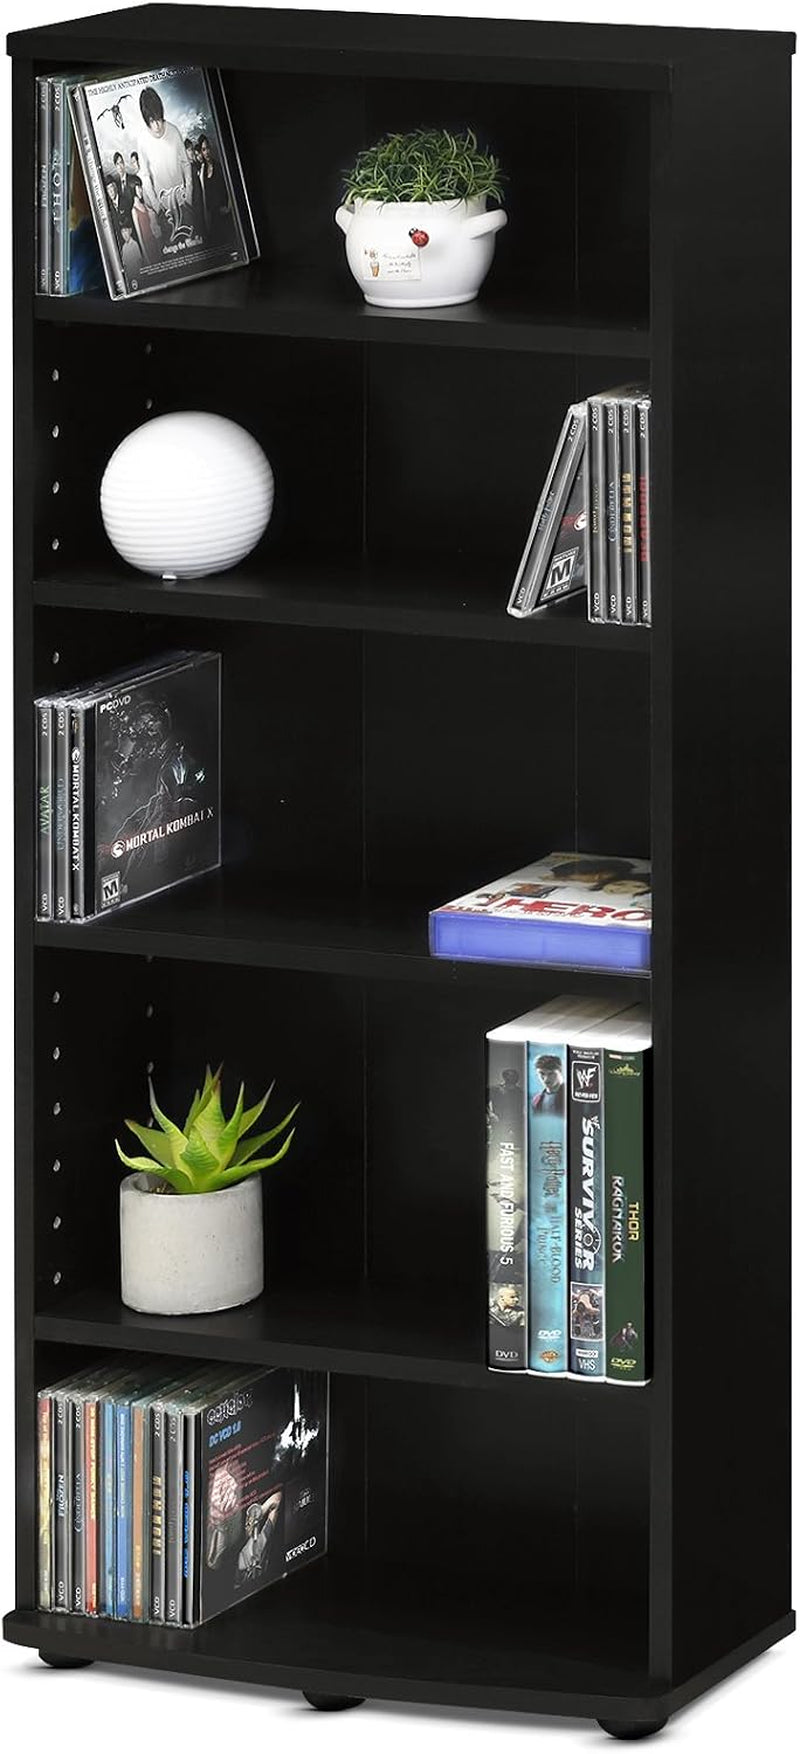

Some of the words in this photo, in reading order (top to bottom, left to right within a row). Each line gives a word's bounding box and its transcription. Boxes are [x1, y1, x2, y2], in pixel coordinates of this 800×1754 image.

[551, 558, 571, 586] M
[72, 765, 80, 813] MORTAL
[40, 785, 50, 835] AVATAR
[72, 813, 80, 862] KOMBAT
[126, 825, 166, 852] MORTAL
[166, 808, 204, 835] KOMBAT
[206, 806, 214, 819] X
[72, 863, 80, 871] X
[103, 879, 118, 901] M
[496, 897, 652, 922] HERO
[499, 1142, 515, 1173] FAST
[499, 1174, 515, 1199] AND
[582, 1117, 595, 1272] SURVIVOR
[499, 1200, 515, 1253] FURIOUS
[612, 1175, 626, 1263] RAGNAROK
[628, 1202, 639, 1241] THOR
[574, 1206, 583, 1270] SERIES
[499, 1256, 514, 1266] 5
[495, 1350, 519, 1360] DVD
[578, 1358, 596, 1371] VHS
[57, 1474, 65, 1518] FROZEN
[153, 1596, 161, 1615] VCD
